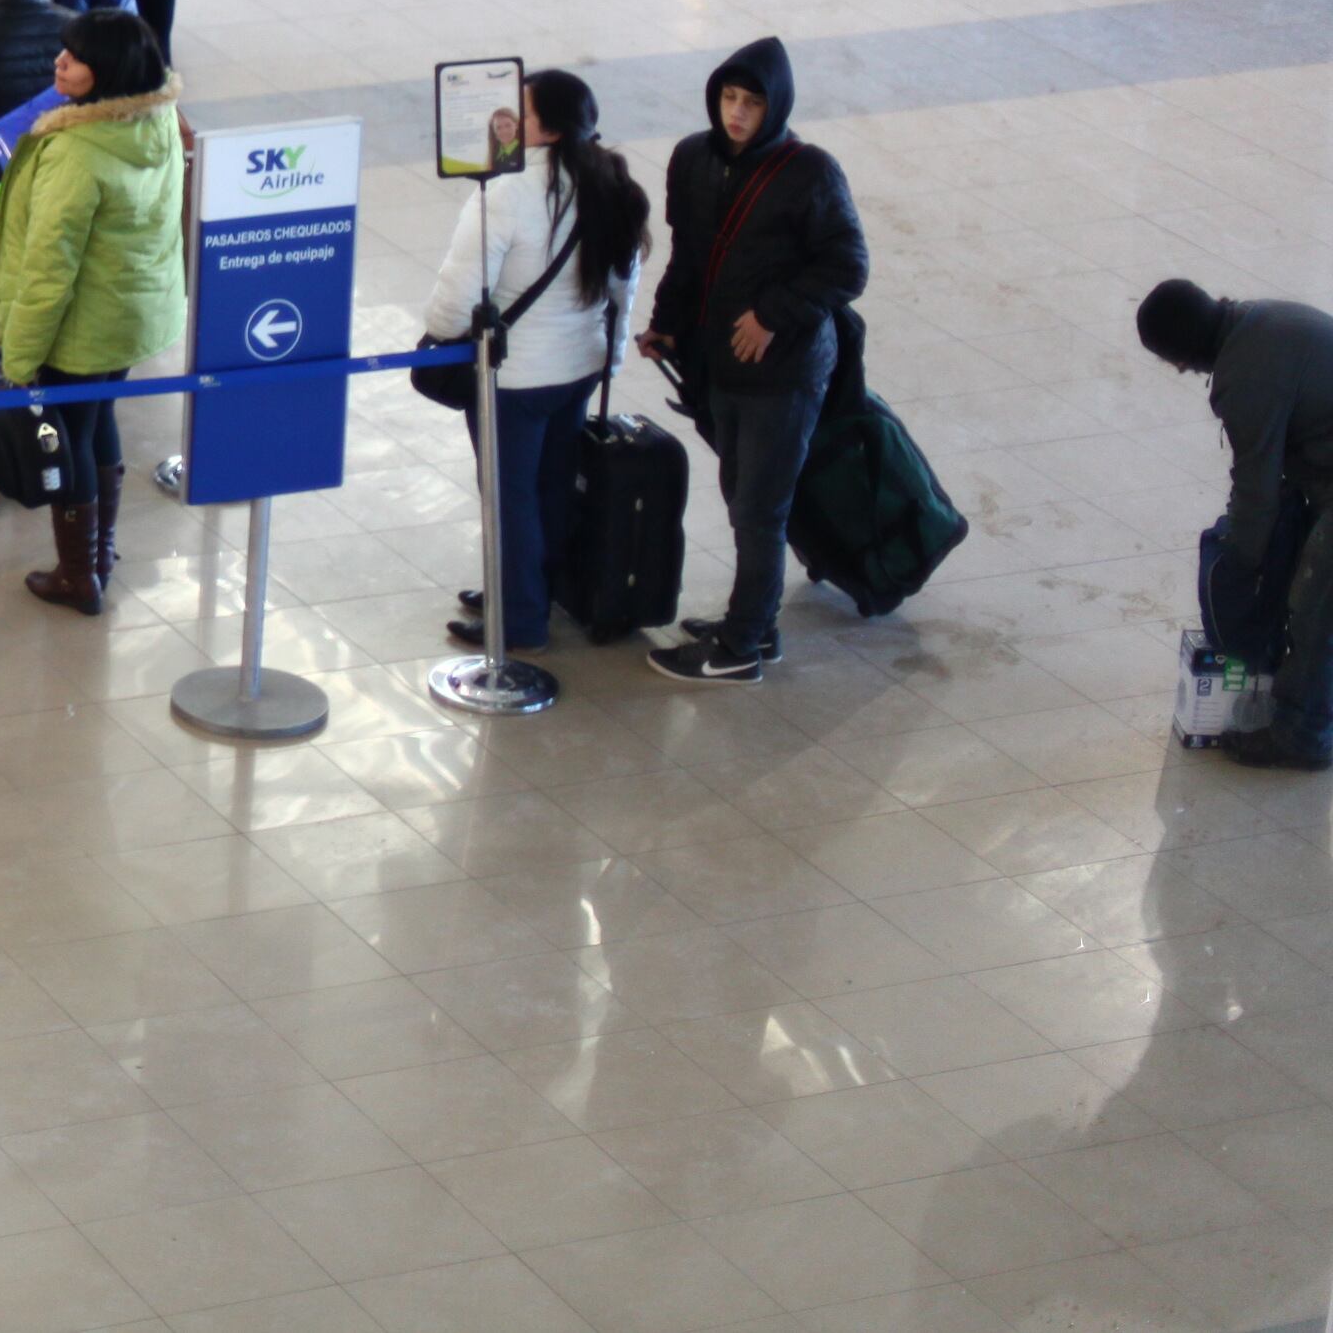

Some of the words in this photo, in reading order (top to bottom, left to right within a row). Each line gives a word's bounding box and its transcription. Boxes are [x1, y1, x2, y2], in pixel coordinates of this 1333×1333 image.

[246, 144, 307, 174] SKY
[260, 171, 324, 191] Airline
[205, 229, 271, 248] PASAJEROS
[274, 220, 351, 241] CHEQUEADOS
[219, 253, 265, 270] Entrega
[268, 250, 283, 264] de
[285, 244, 335, 265] equipaje
